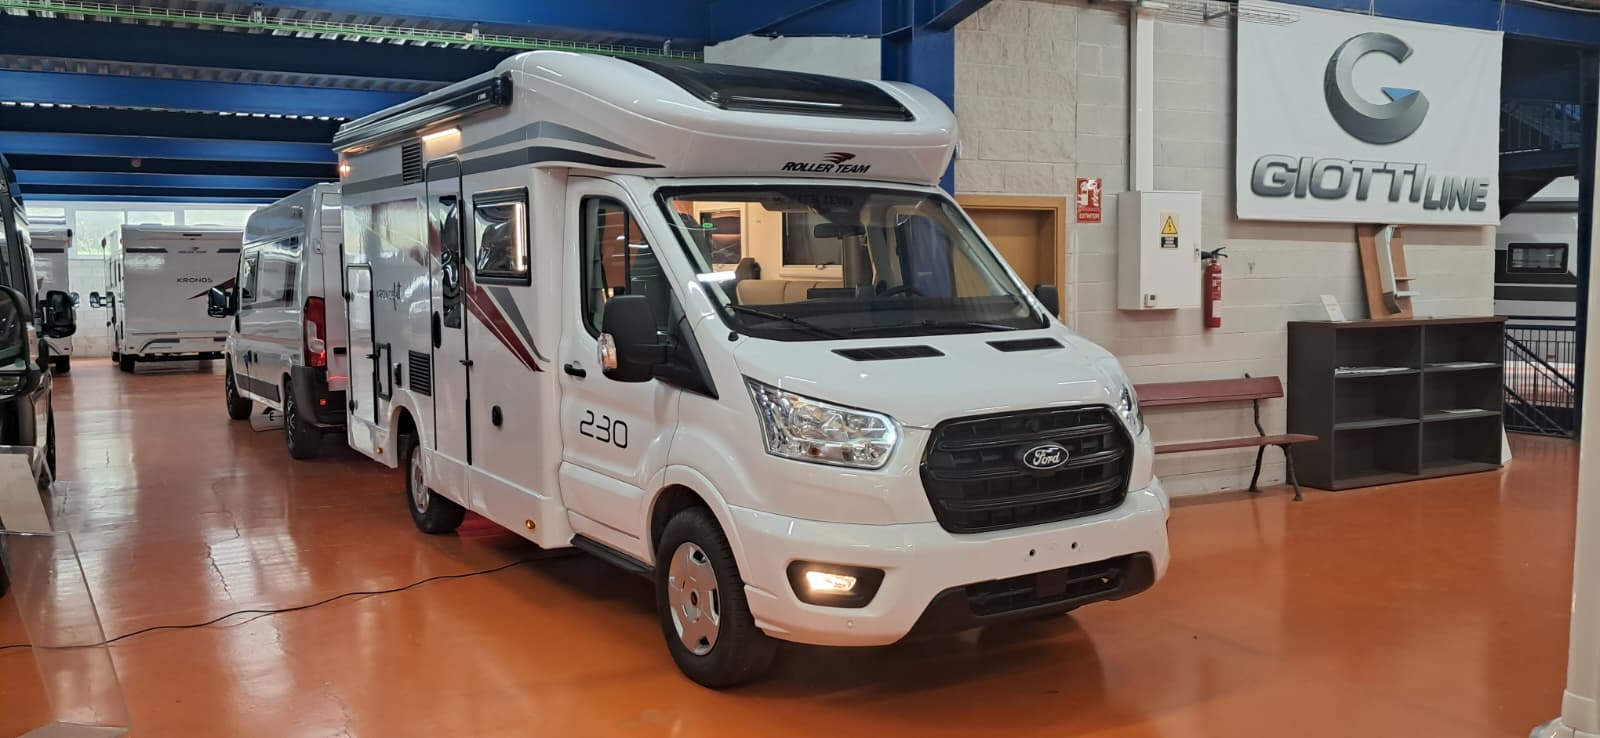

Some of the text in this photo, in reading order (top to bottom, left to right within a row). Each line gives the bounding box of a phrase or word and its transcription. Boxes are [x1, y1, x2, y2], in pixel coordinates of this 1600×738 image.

[781, 161, 871, 174] ROLLER TEAM
[580, 410, 628, 449] 230
[1033, 447, 1061, 466] Ford
